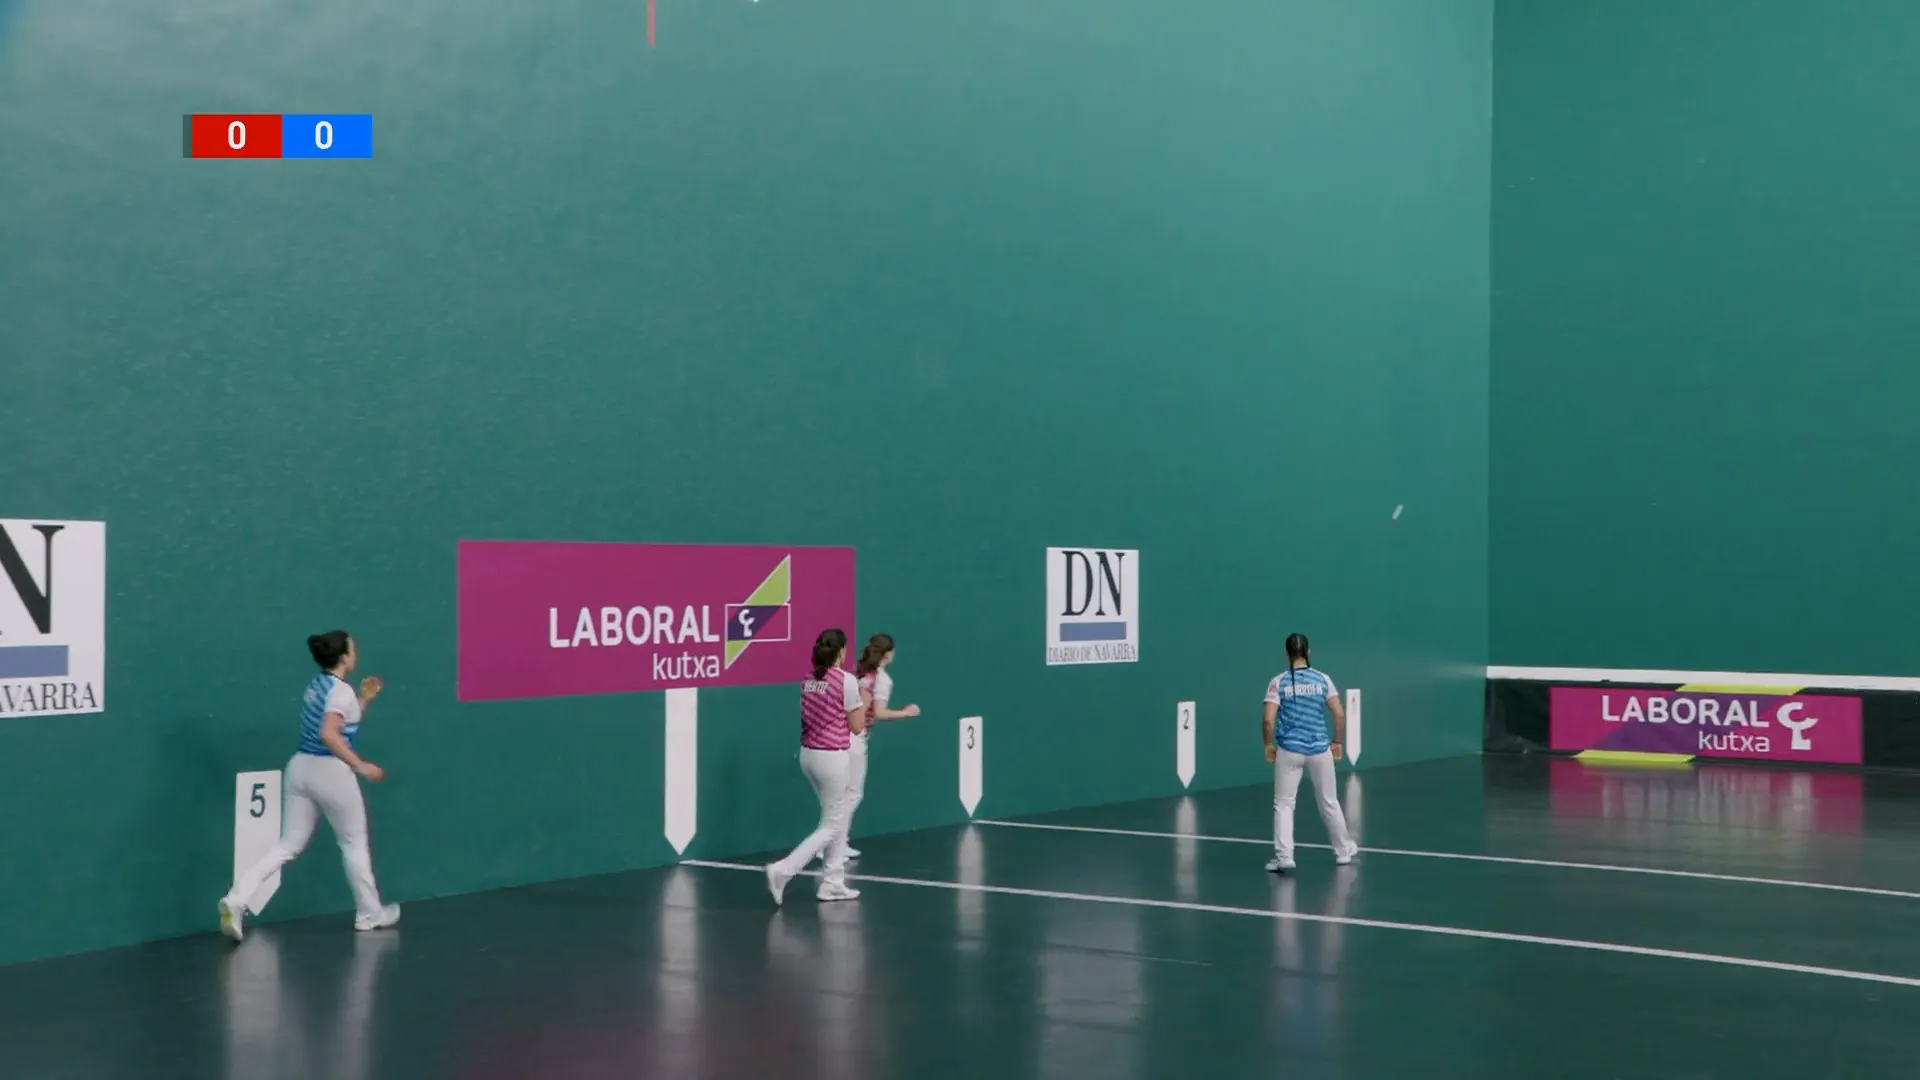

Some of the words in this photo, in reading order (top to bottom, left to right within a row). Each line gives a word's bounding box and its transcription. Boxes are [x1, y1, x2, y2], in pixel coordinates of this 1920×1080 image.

[1061, 550, 1125, 616] DN
[549, 605, 720, 648] LABORAL
[652, 651, 720, 680] kutxa
[0, 682, 98, 712] VARRA
[1601, 695, 1770, 728] LABORAL
[1183, 708, 1190, 730] 2
[966, 724, 976, 750] 3
[1698, 730, 1770, 752] kutxa
[249, 782, 266, 818] 5
